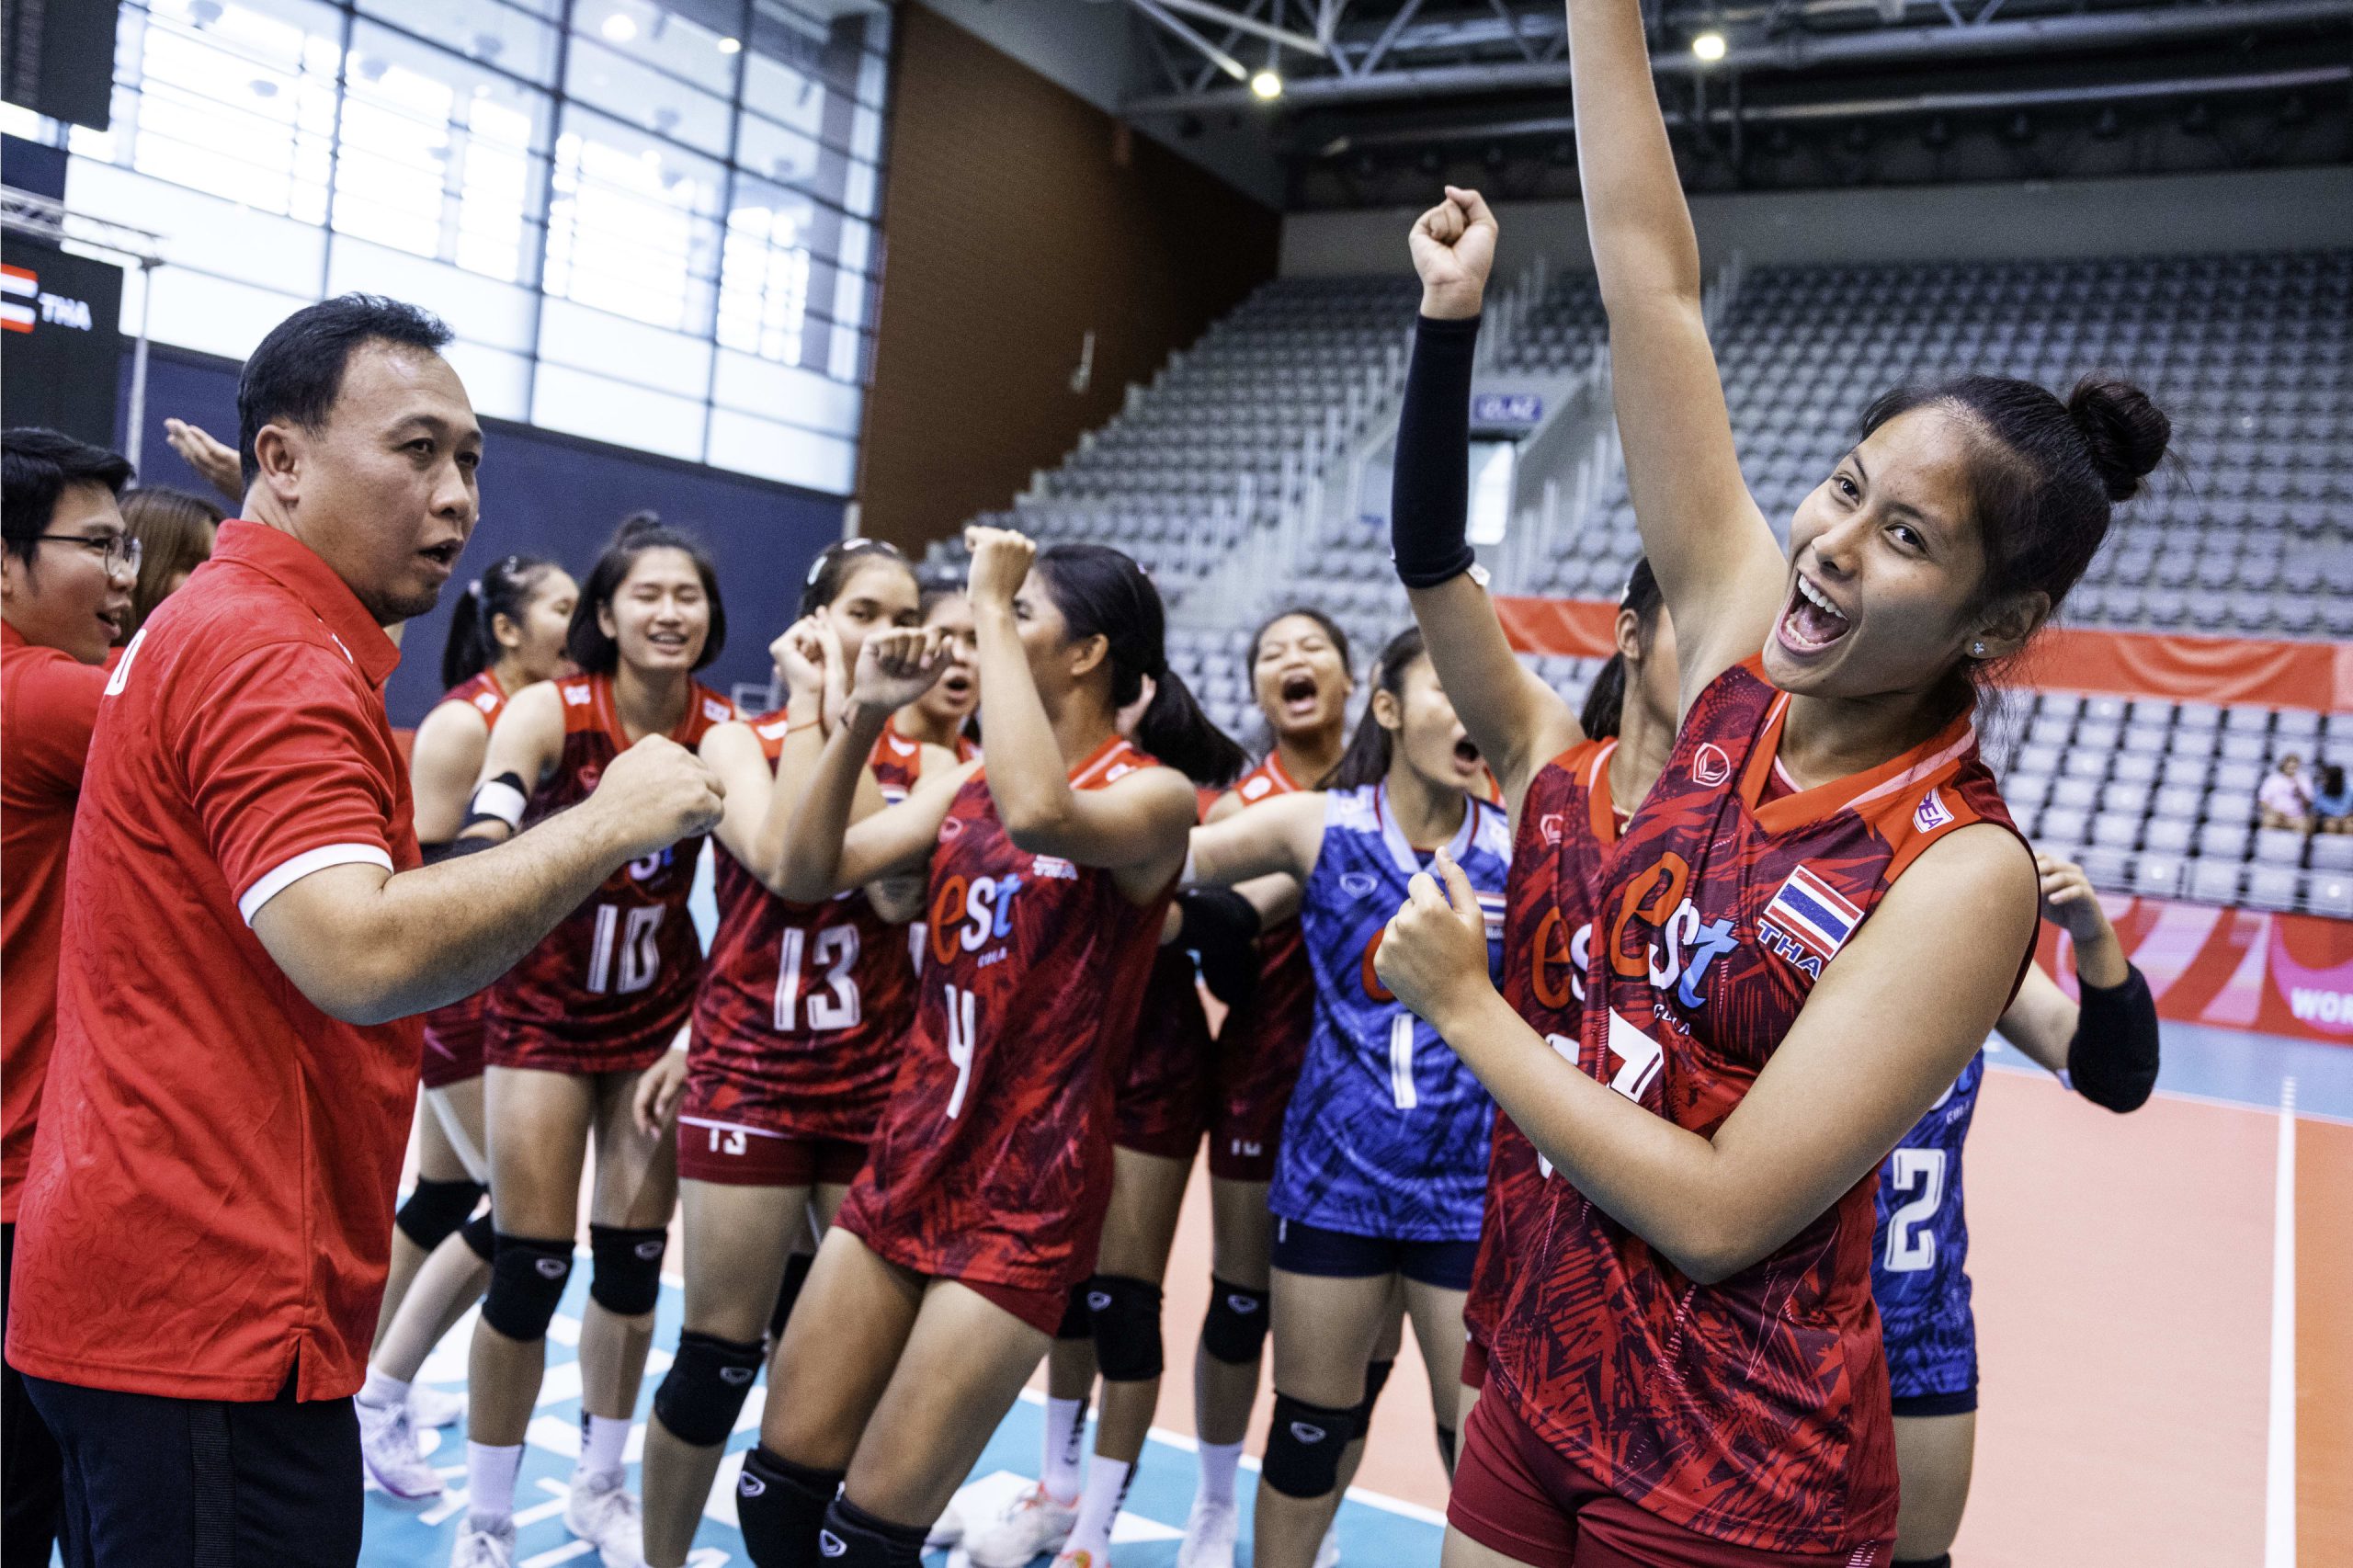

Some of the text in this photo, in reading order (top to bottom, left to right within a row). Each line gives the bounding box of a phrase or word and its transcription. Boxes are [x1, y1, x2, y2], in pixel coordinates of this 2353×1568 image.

[38, 291, 92, 332] THA
[586, 903, 667, 994] 10
[931, 872, 1024, 964] est
[1610, 851, 1740, 1009] est
[1756, 917, 1824, 982] THA
[773, 923, 861, 1031] 13
[944, 983, 975, 1120] 4
[1390, 1013, 1417, 1109] 1
[1883, 1148, 1947, 1272] 2
